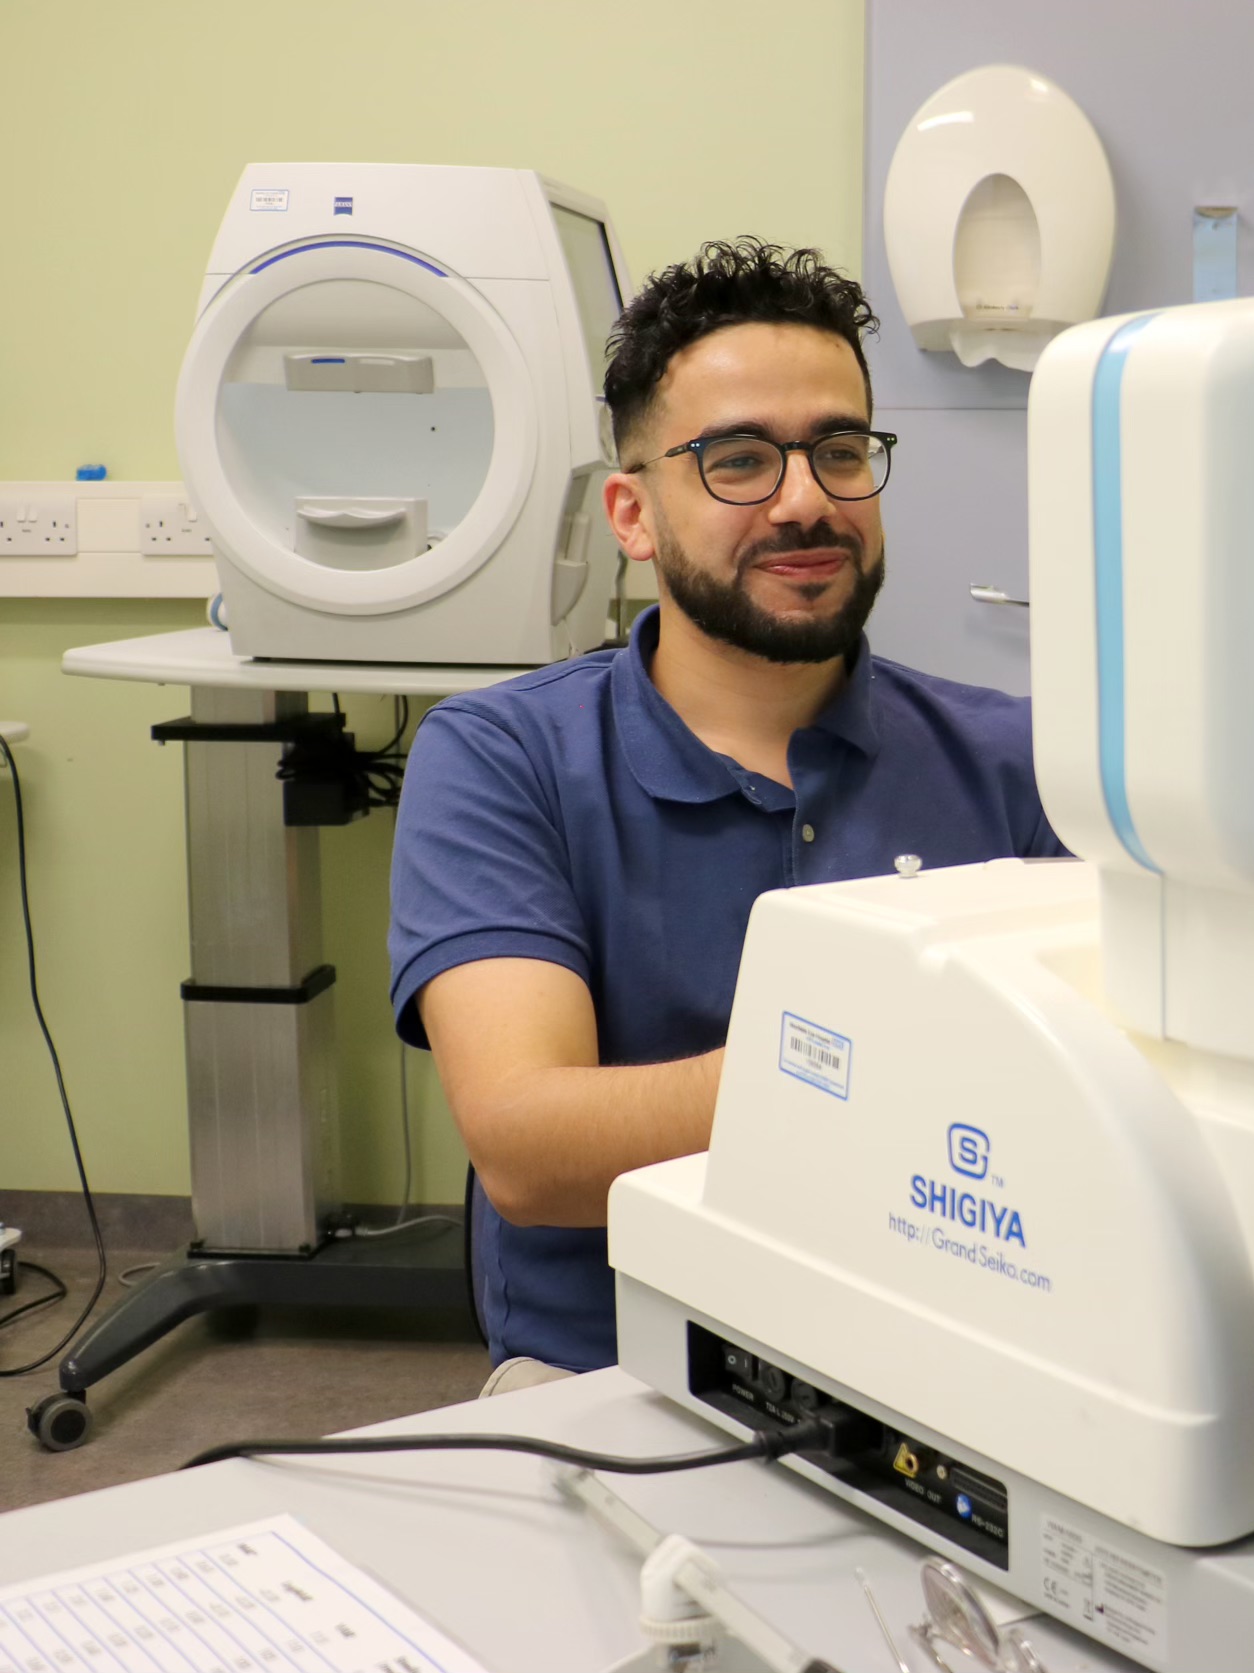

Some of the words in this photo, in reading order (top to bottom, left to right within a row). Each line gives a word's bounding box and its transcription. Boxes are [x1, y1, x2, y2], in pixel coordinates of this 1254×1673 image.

[909, 1174, 1026, 1249] SHIGIYA
[732, 1383, 754, 1401] POWER
[904, 1477, 925, 1496] VIDEO
[926, 1490, 942, 1504] OUT
